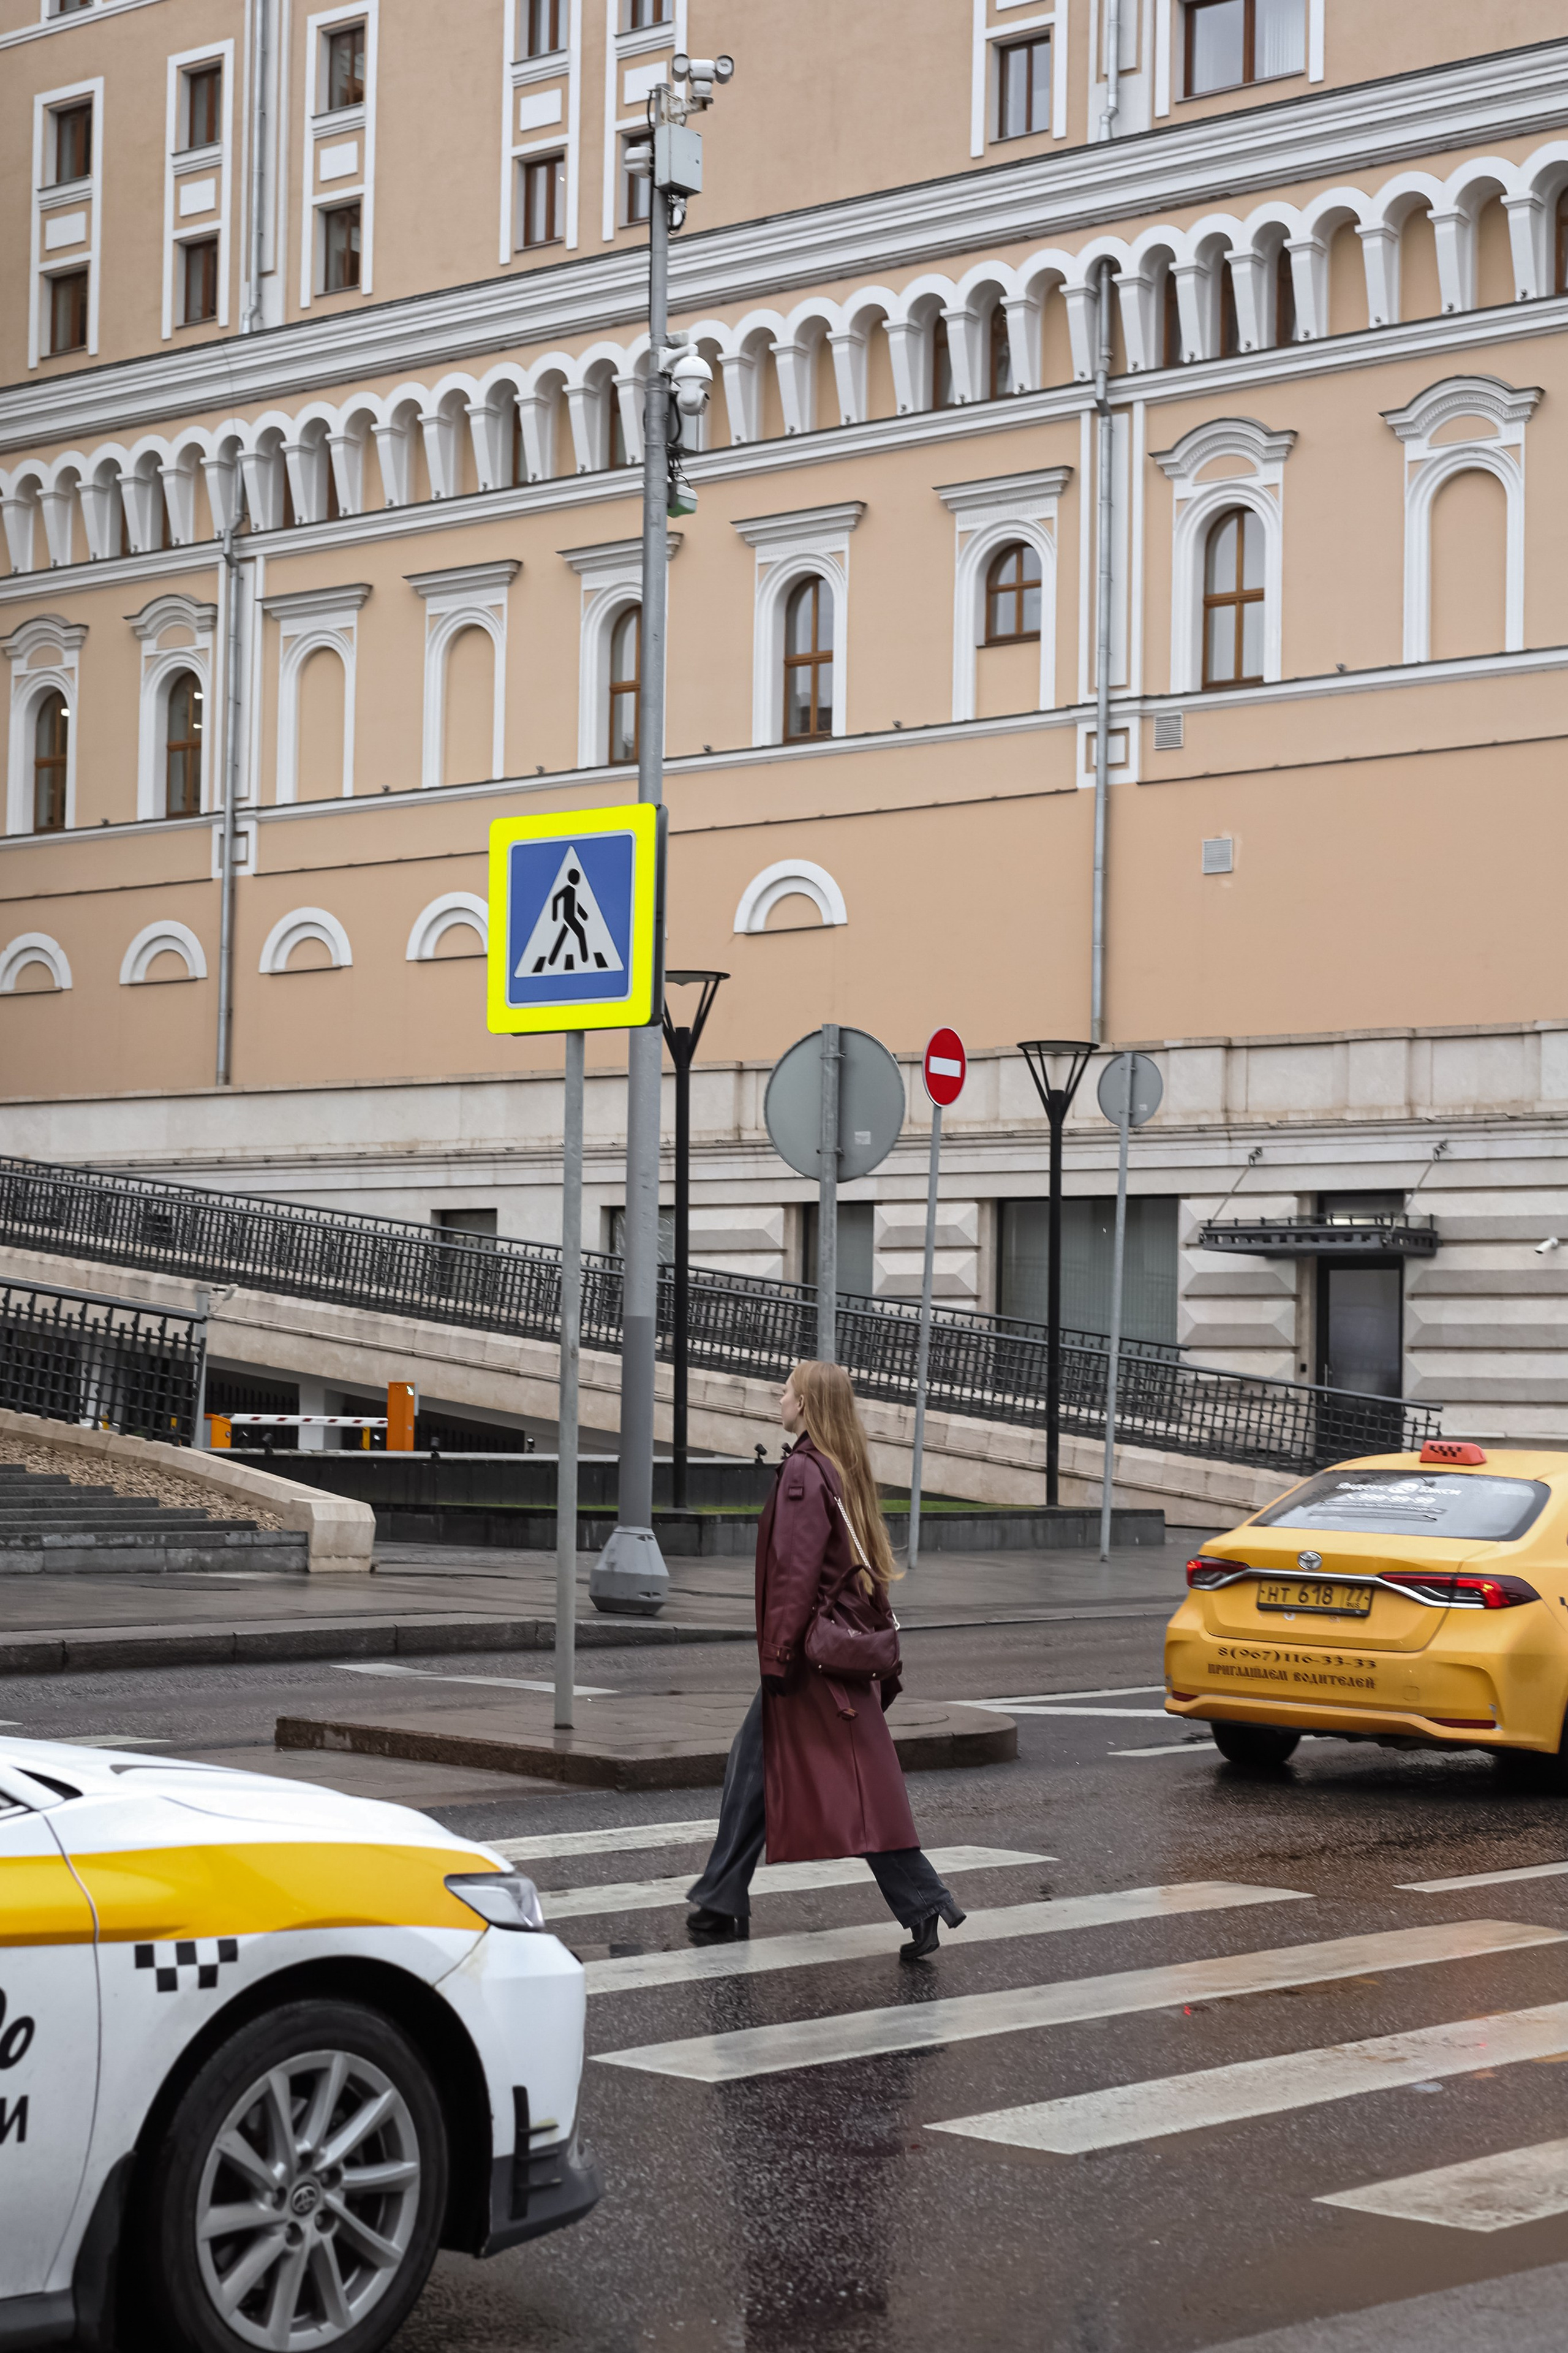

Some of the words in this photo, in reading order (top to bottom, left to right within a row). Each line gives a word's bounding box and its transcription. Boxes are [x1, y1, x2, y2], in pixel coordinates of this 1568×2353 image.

[1298, 1584, 1334, 1605] 618
[1207, 1663, 1288, 1682] ПРИГЛАШАЕМ
[1292, 1671, 1376, 1690] ВОДИТЕЛЕЙ
